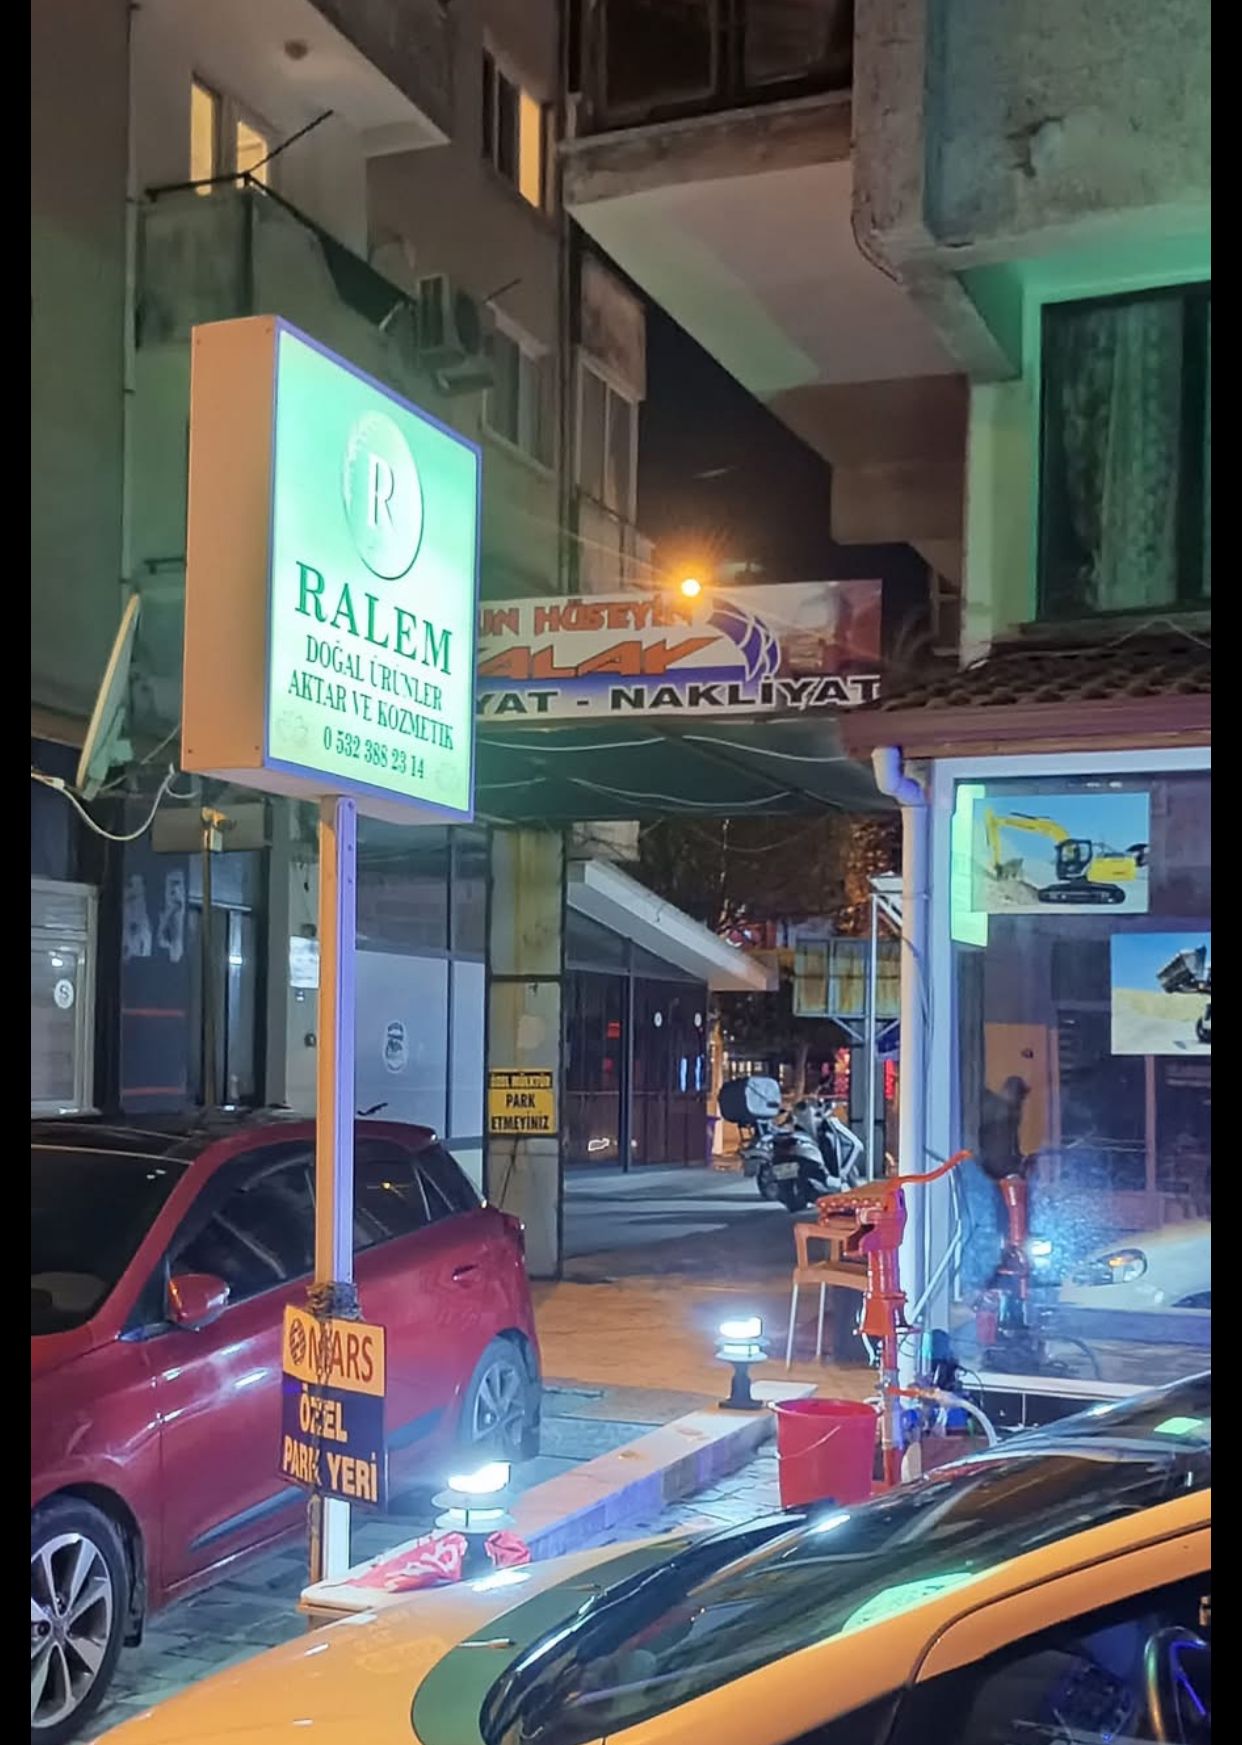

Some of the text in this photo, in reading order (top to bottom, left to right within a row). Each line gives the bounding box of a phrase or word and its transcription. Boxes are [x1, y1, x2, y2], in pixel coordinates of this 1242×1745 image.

[294, 560, 453, 676] RALEM
[287, 669, 347, 713] AKTAR
[351, 690, 372, 721] VE
[305, 634, 443, 711] DOĞAL ÜRÜNLER
[610, 674, 880, 711] NAKLİYAT
[323, 725, 424, 779] 0 532 388 23 14
[505, 1093, 536, 1108] PARK
[299, 1383, 349, 1443] ÖZEL
[283, 1434, 378, 1503] PARK YERİ
